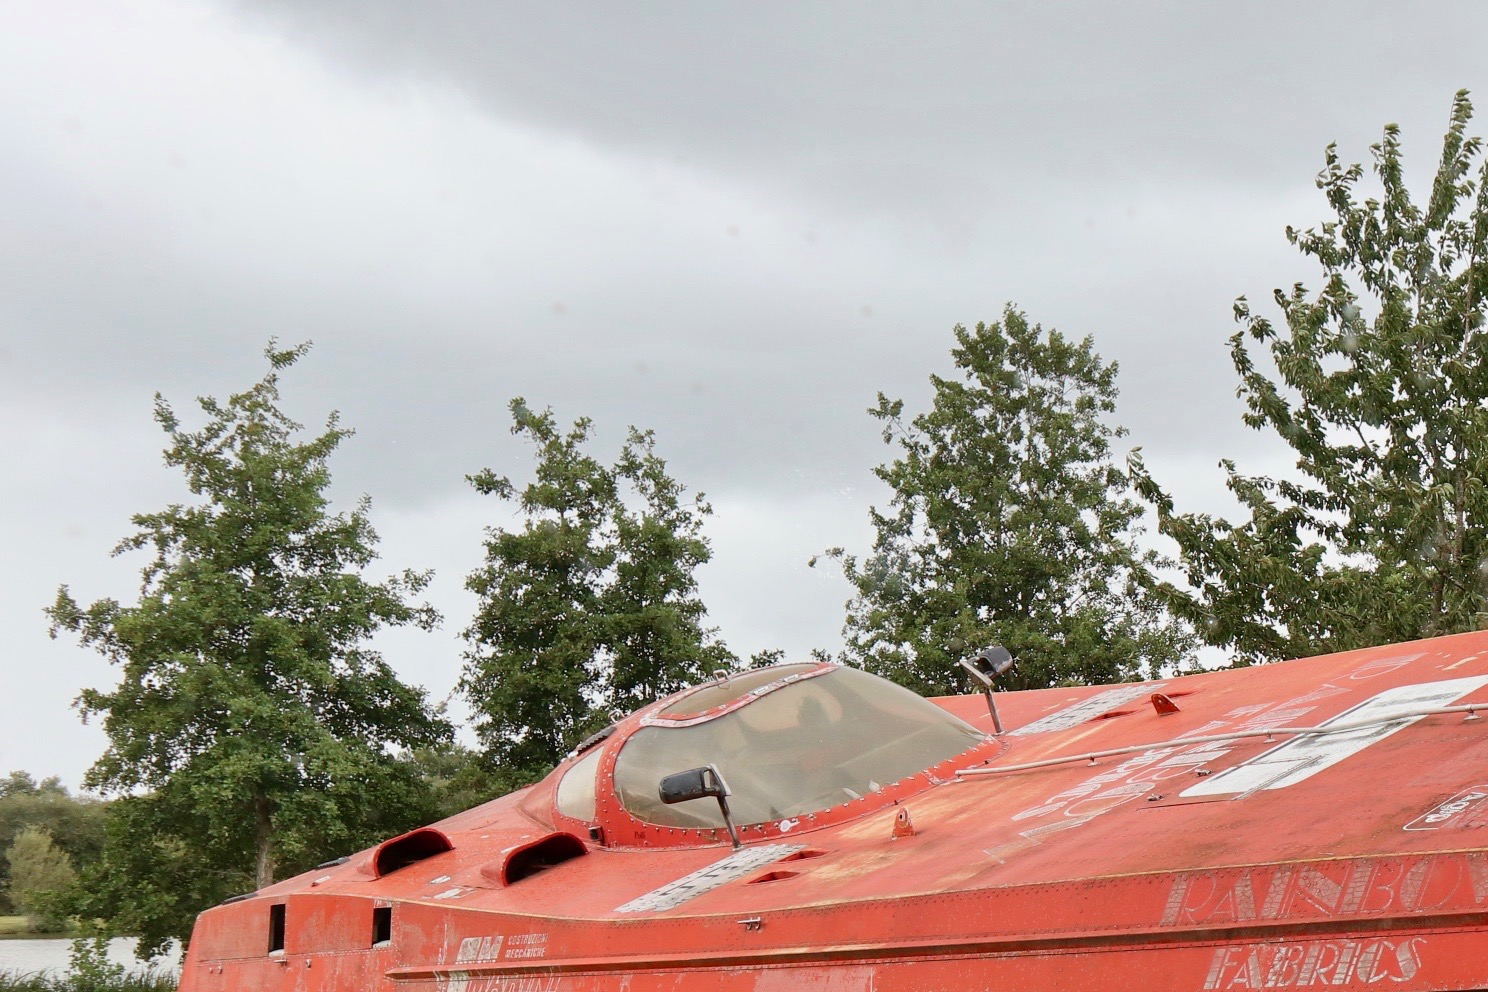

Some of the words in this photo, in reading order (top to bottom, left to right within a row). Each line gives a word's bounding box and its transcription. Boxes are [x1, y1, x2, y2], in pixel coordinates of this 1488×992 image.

[507, 933, 548, 946] COSTRUZIONI
[504, 947, 546, 959] MECCANICHE
[1203, 937, 1428, 991] FABRICS
